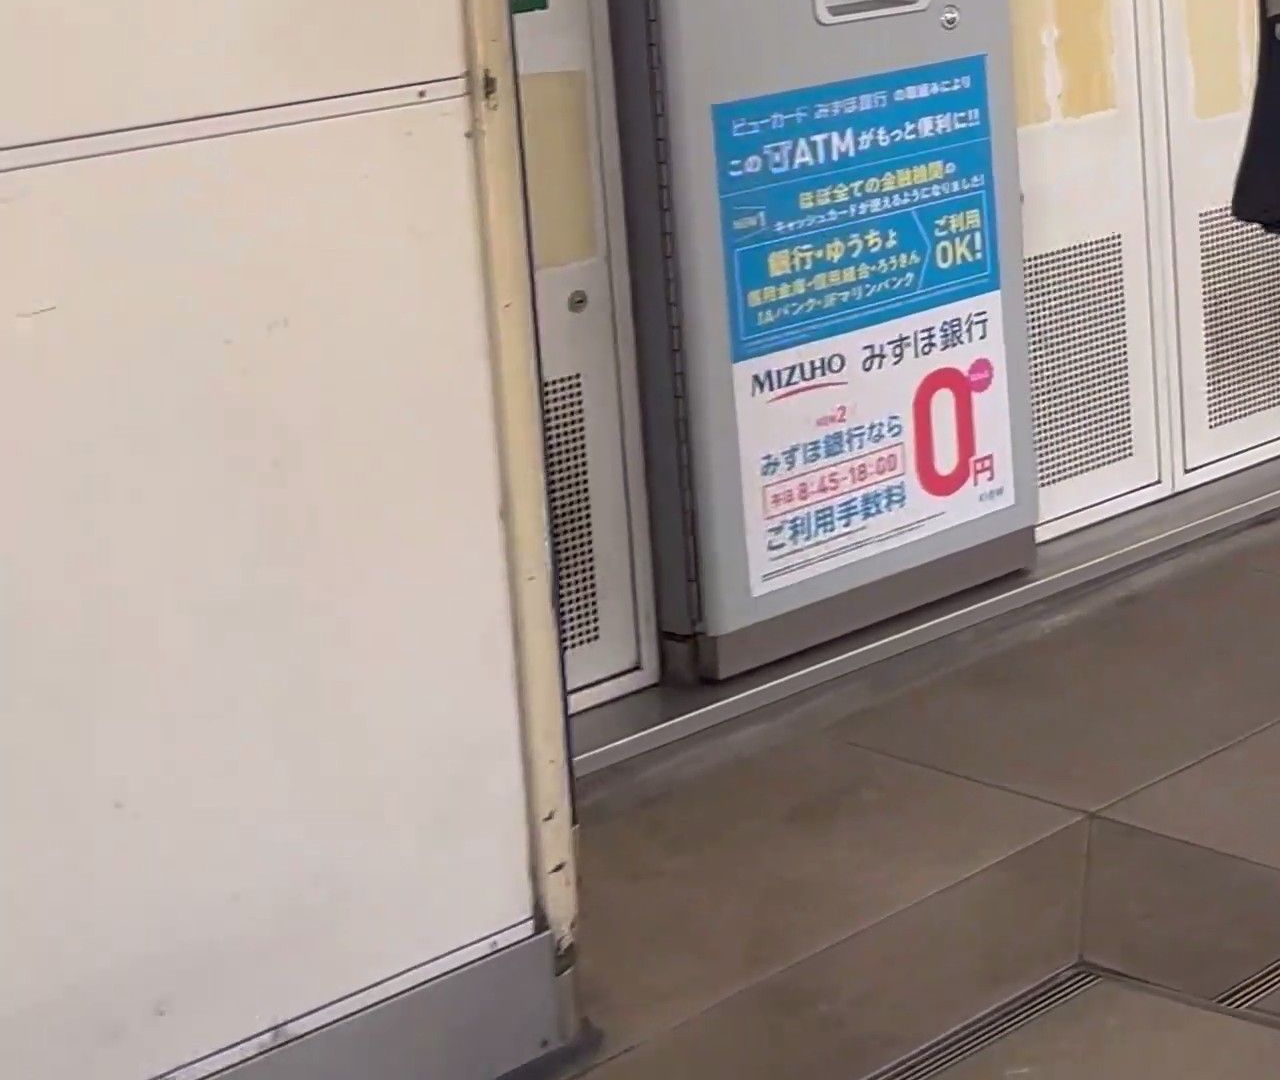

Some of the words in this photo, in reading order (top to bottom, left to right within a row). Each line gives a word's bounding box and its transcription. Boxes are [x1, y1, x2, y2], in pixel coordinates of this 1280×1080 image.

[936, 231, 983, 270] OK!
[751, 353, 847, 397] MIZUHO
[861, 310, 989, 372] みずほ銀行
[760, 414, 903, 477] みずほ銀行なら
[766, 480, 908, 552] ご利用手数料
